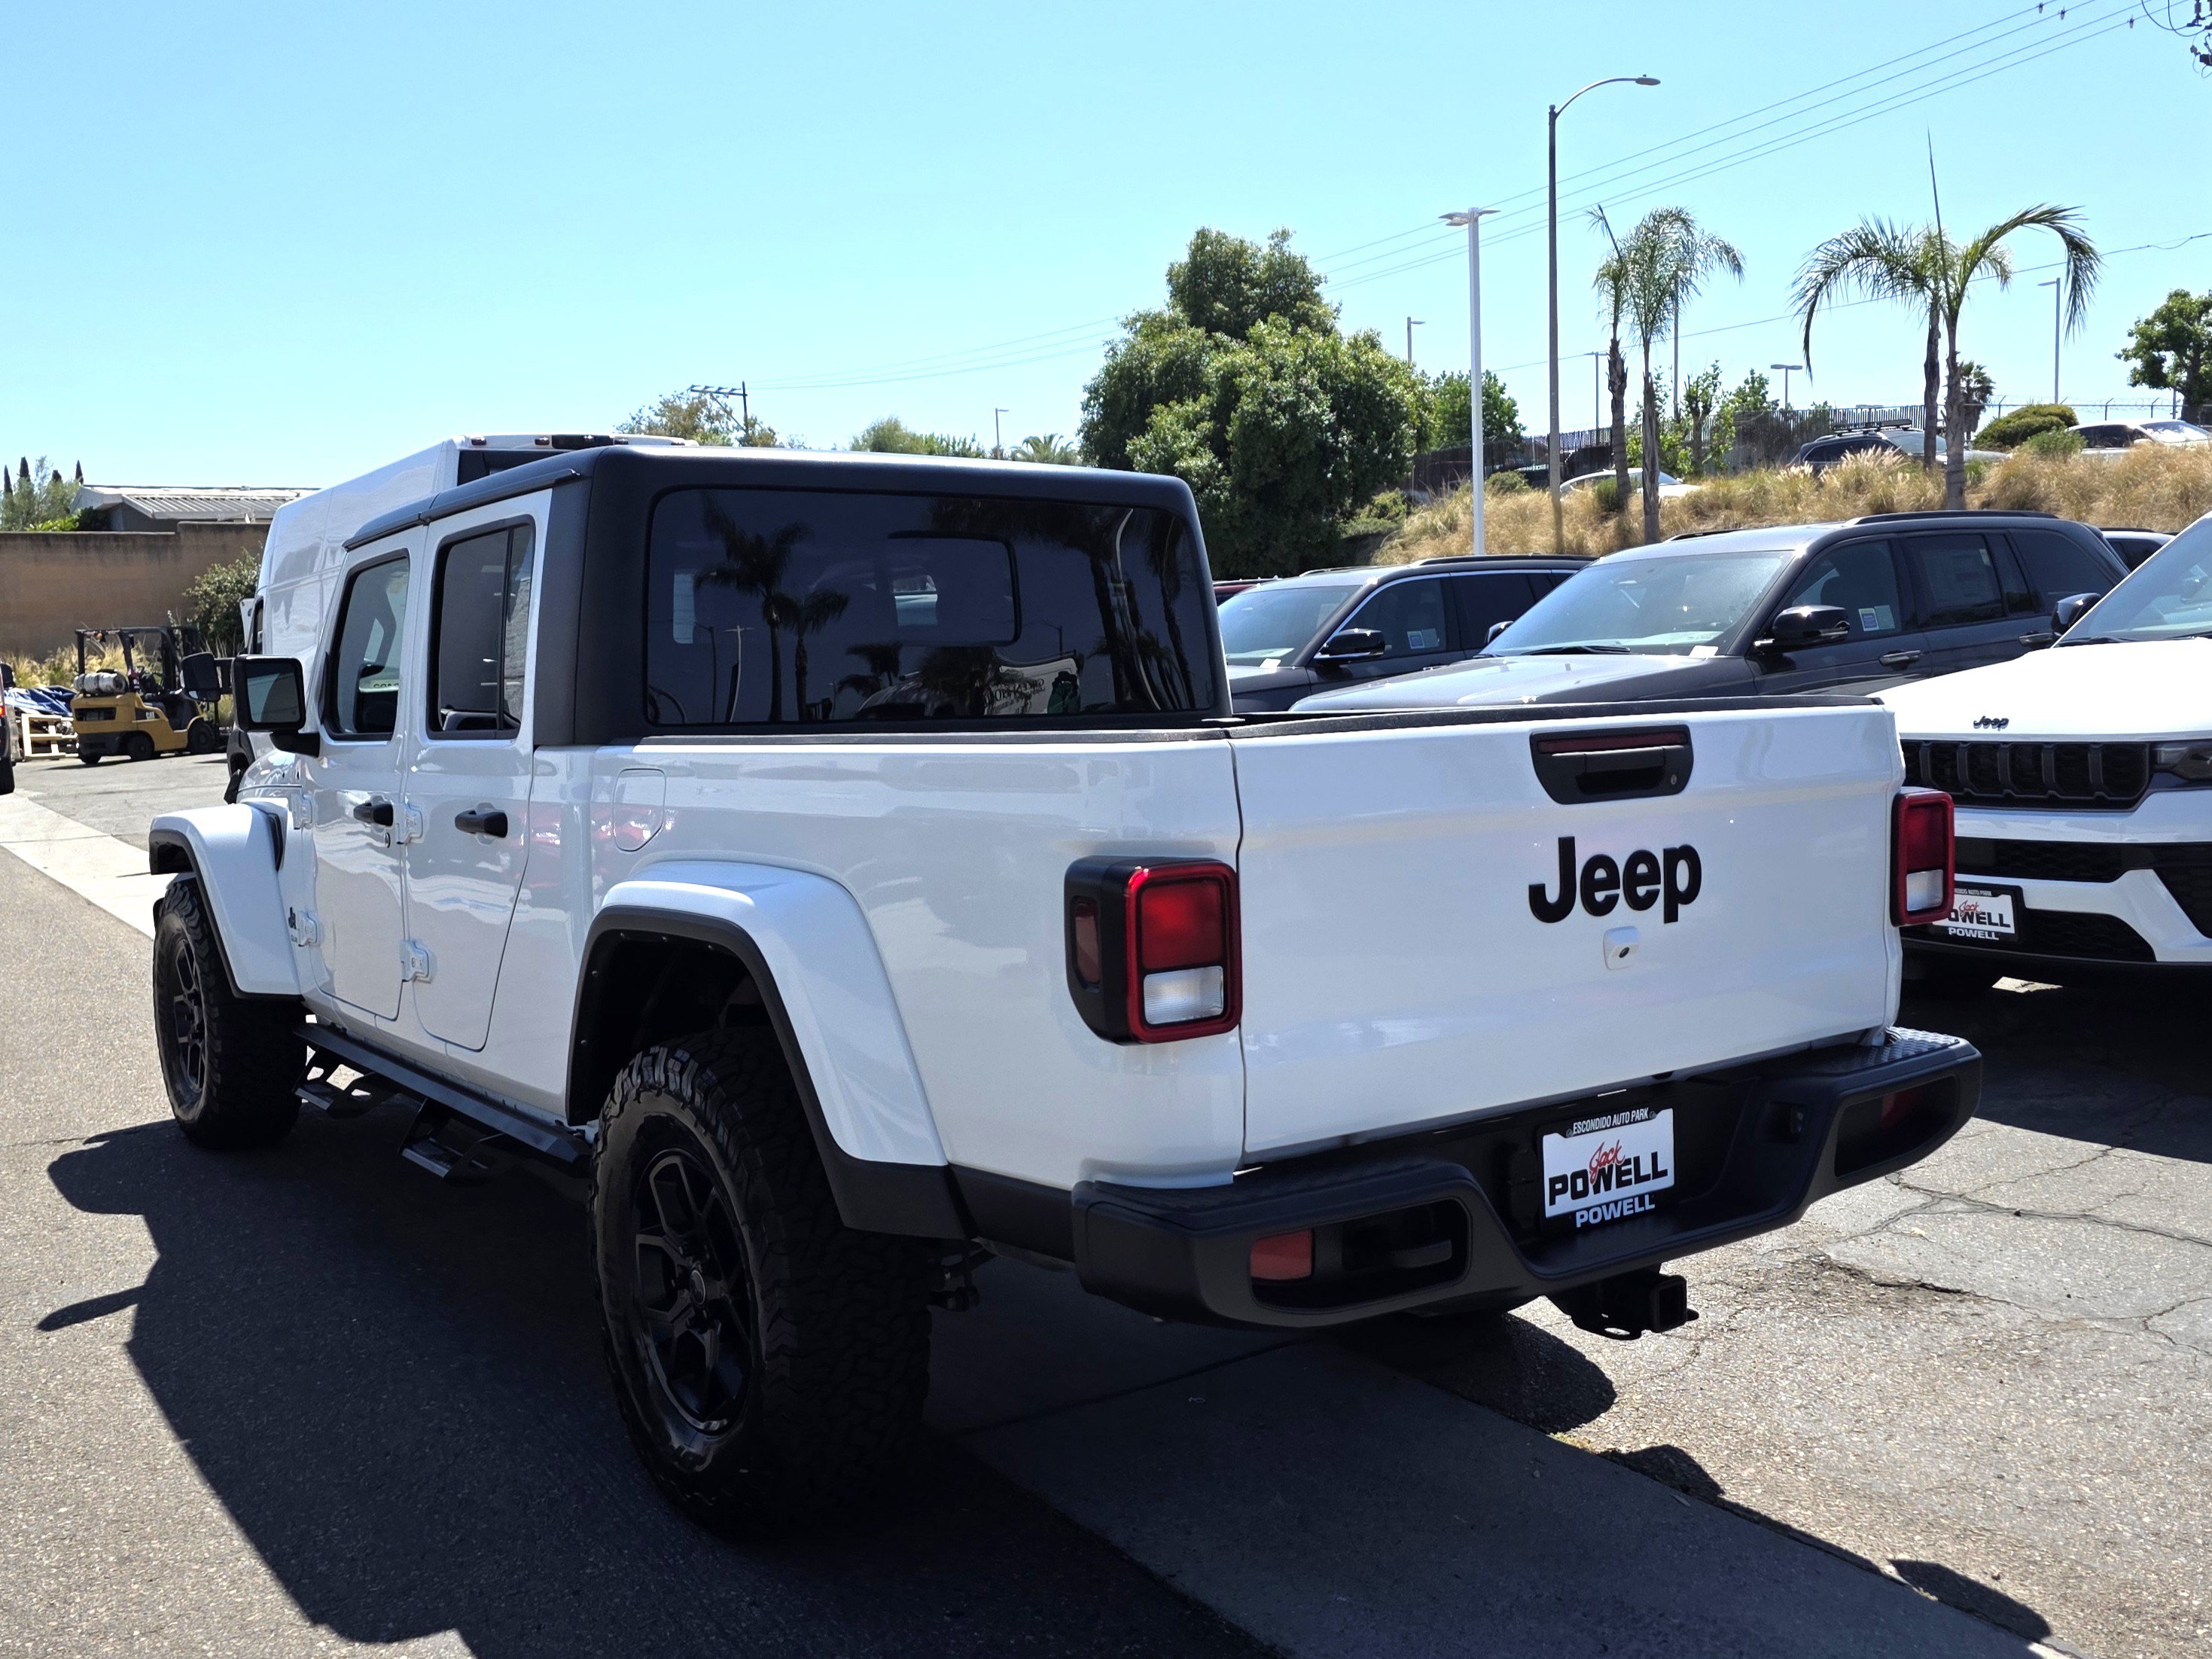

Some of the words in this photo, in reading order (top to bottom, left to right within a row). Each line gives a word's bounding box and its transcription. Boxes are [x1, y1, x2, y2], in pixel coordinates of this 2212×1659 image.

[1973, 715, 2009, 730] Jeep
[1528, 836, 1702, 924] Jeep
[1947, 908, 2011, 929] OWELL
[1948, 927, 1999, 940] POWELL
[1573, 1115, 1611, 1135] ESCONDIDO
[1612, 1111, 1630, 1127] AUTO
[1631, 1107, 1649, 1124] PARK
[1589, 1139, 1625, 1185] Jack
[1549, 1151, 1668, 1206] POWELL
[1576, 1194, 1655, 1228] POWELL
